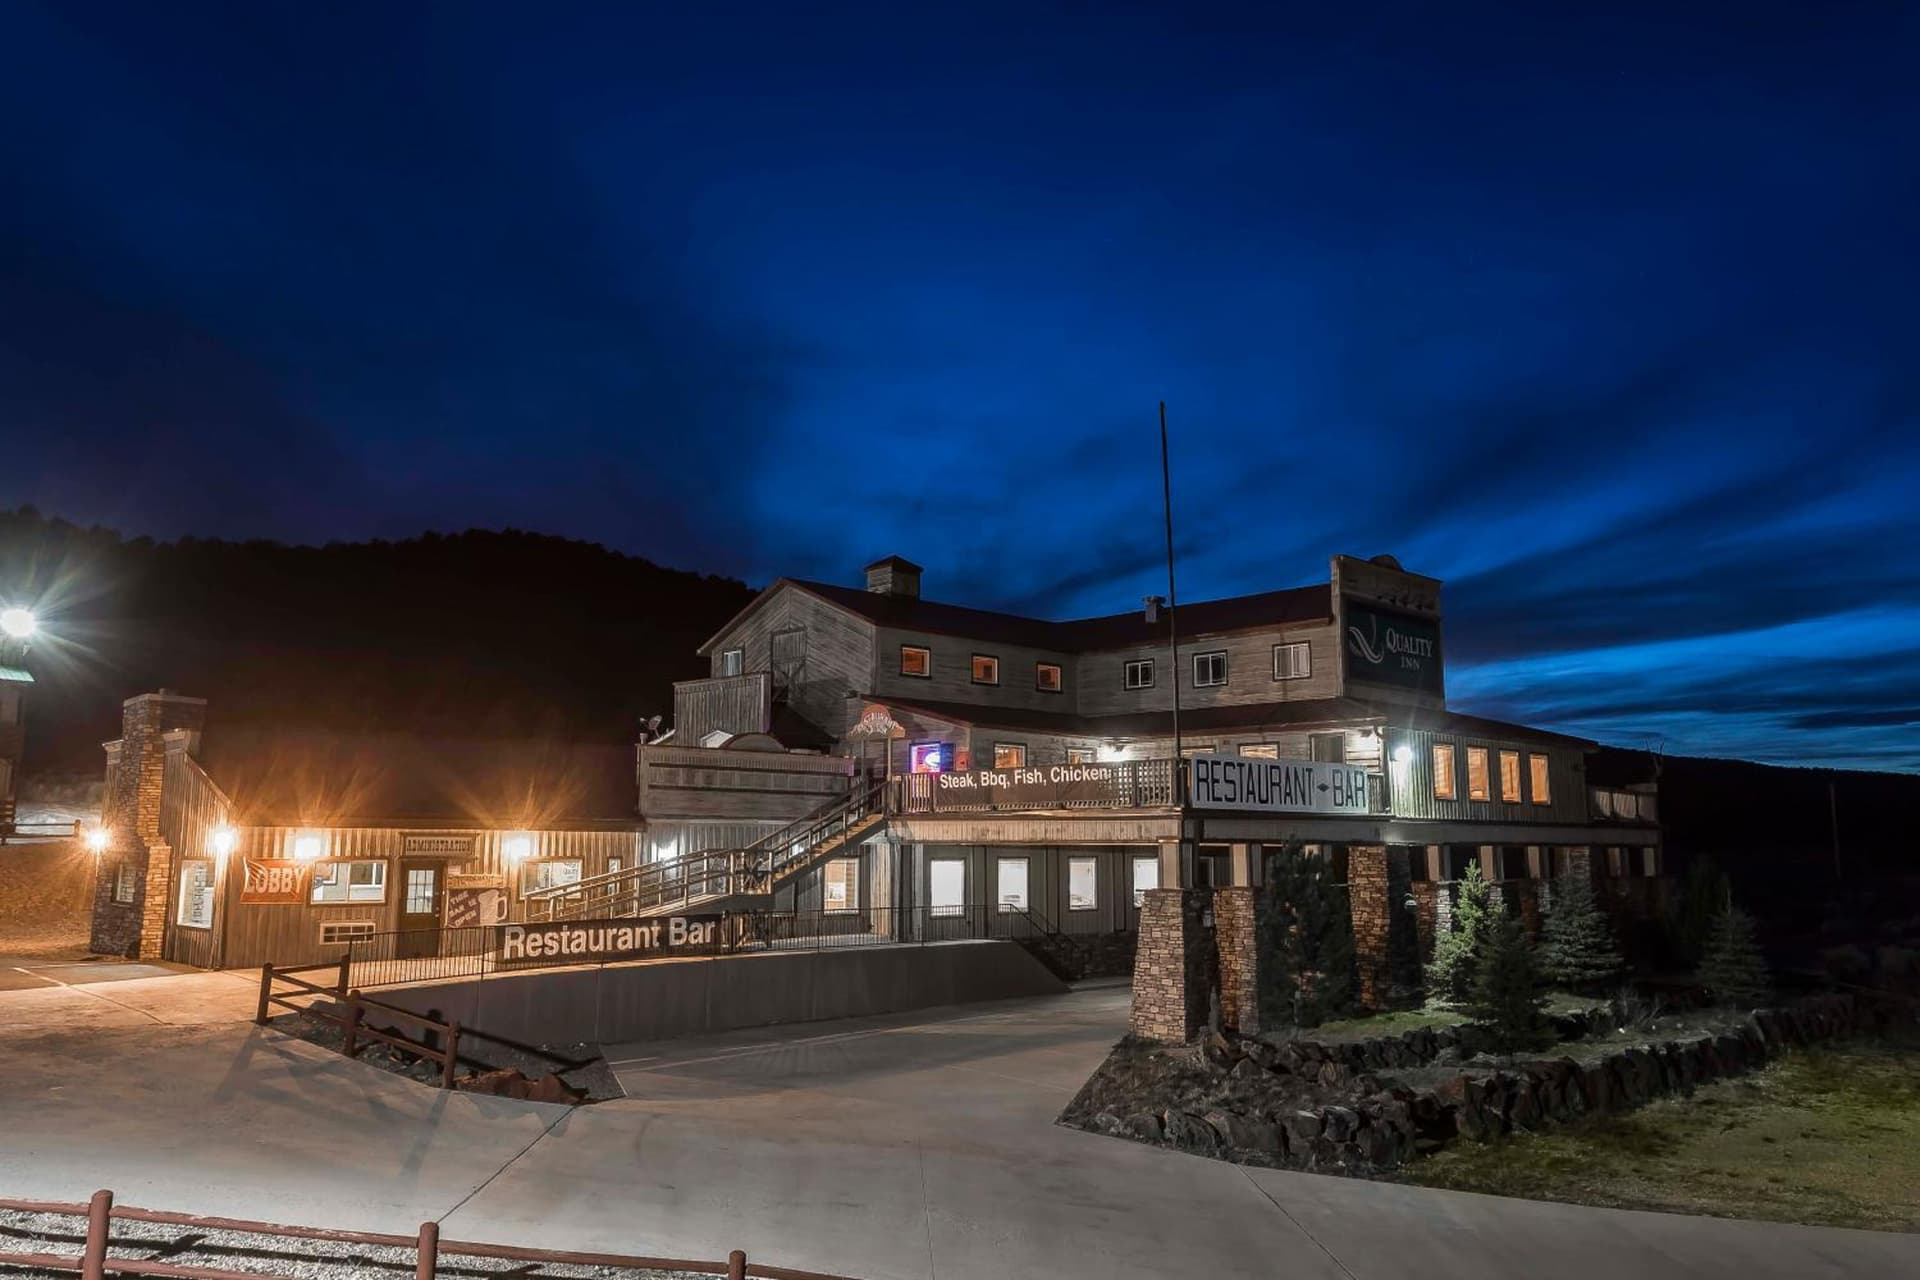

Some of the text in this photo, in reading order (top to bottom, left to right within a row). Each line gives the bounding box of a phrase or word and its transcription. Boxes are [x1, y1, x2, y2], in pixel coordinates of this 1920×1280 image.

[1386, 627, 1432, 657] QUALITY
[1401, 654, 1420, 670] INN
[939, 765, 1109, 789] Steak, Bbq, Fish, Chicken
[1196, 759, 1367, 808] RESTAURANT BAR
[406, 839, 471, 852] ADMINISTRATION
[243, 857, 306, 894] LOBBY
[455, 910, 477, 927] OPEN
[503, 917, 716, 959] Restaurant Bar
